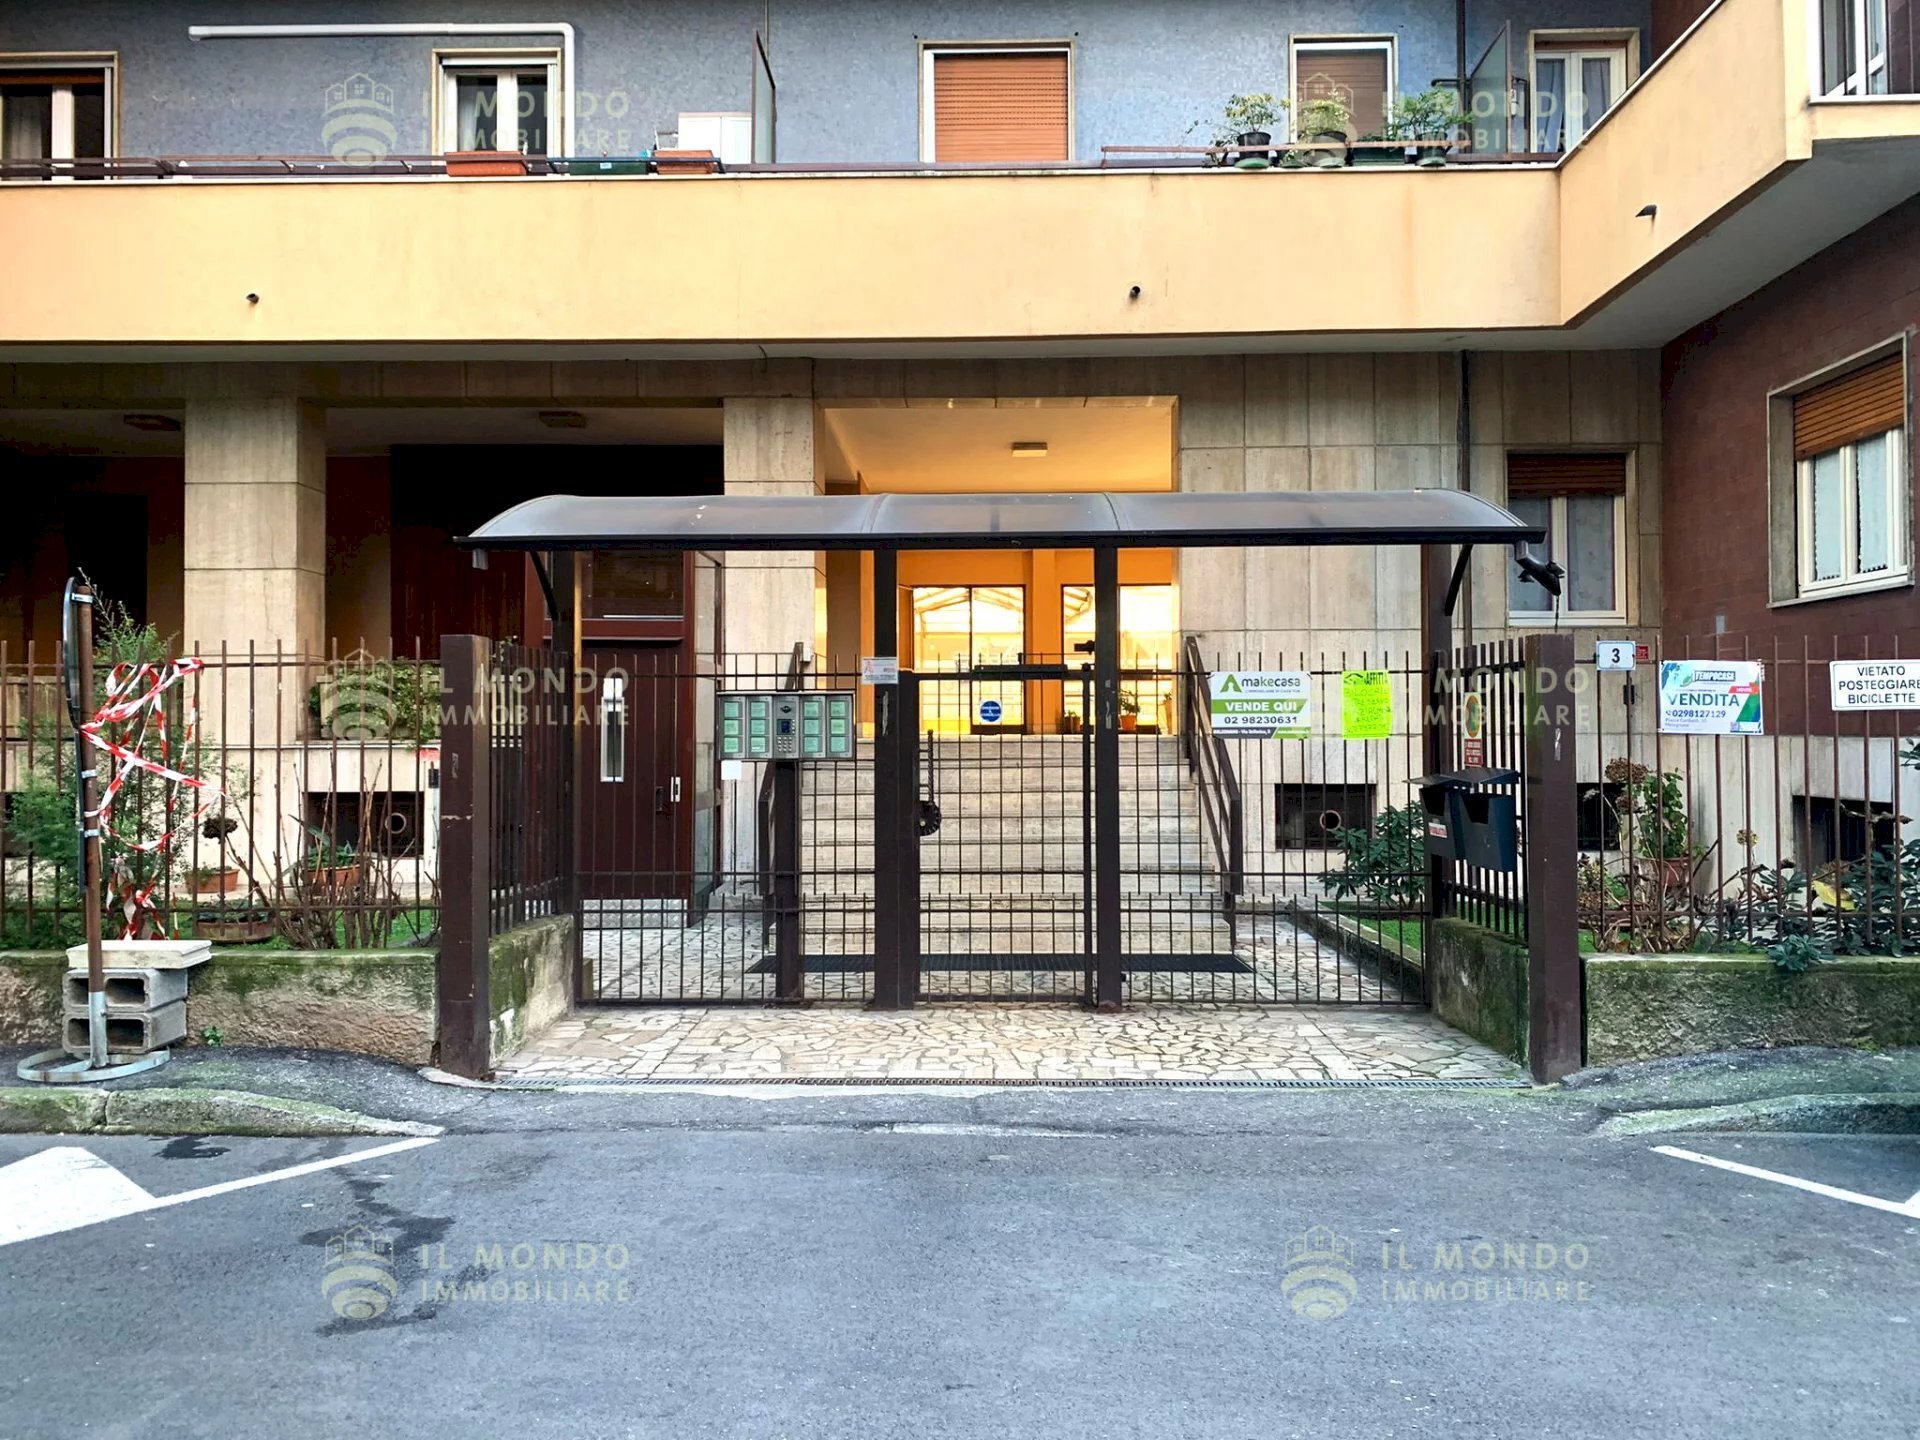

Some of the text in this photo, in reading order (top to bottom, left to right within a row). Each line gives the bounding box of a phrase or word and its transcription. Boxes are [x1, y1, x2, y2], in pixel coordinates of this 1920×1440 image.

[1611, 647, 1621, 664] 3
[1857, 665, 1906, 676] VIETATO
[1241, 676, 1301, 687] makecasa
[1838, 679, 1920, 691] POSTEGGIARE
[1666, 693, 1740, 707] VENDITA
[1848, 693, 1916, 704] BICICLETTE
[1225, 701, 1298, 712] VENDE QUI
[1672, 709, 1726, 718] 0298127129
[1224, 716, 1298, 725] 02 98230631
